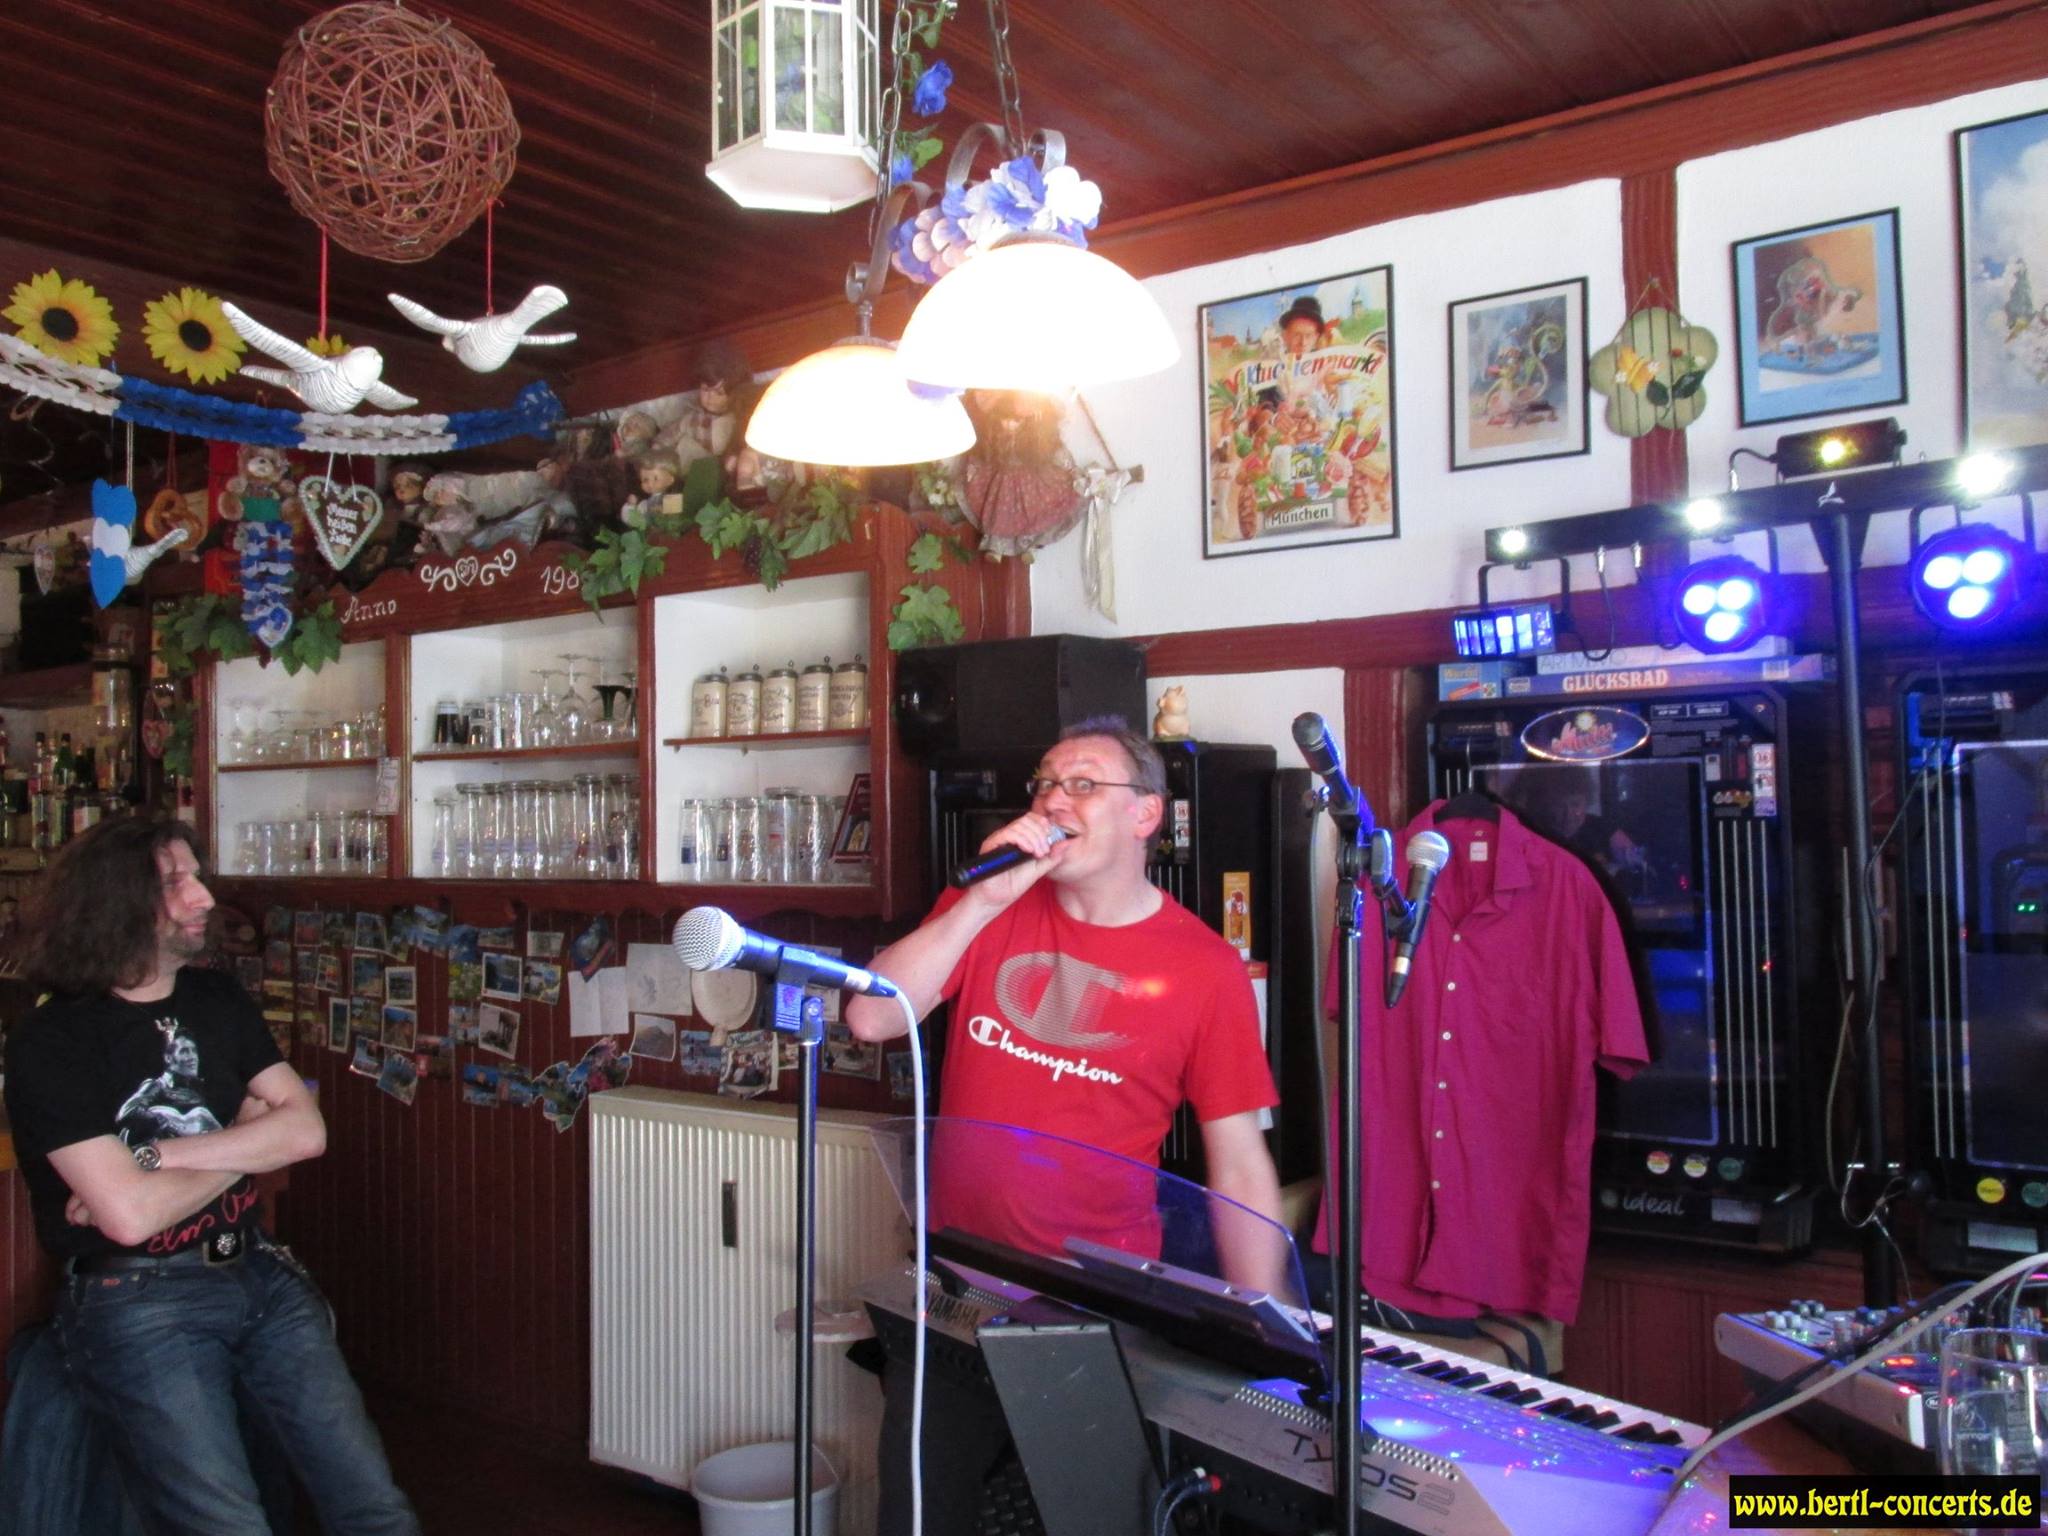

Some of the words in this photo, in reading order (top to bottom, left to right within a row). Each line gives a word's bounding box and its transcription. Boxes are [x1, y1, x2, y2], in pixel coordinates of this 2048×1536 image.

[1271, 506, 1330, 528] München
[340, 597, 397, 624] Anno
[540, 565, 580, 595] 198
[968, 1015, 1123, 1085] Champion
[1621, 1190, 1686, 1216] ideal
